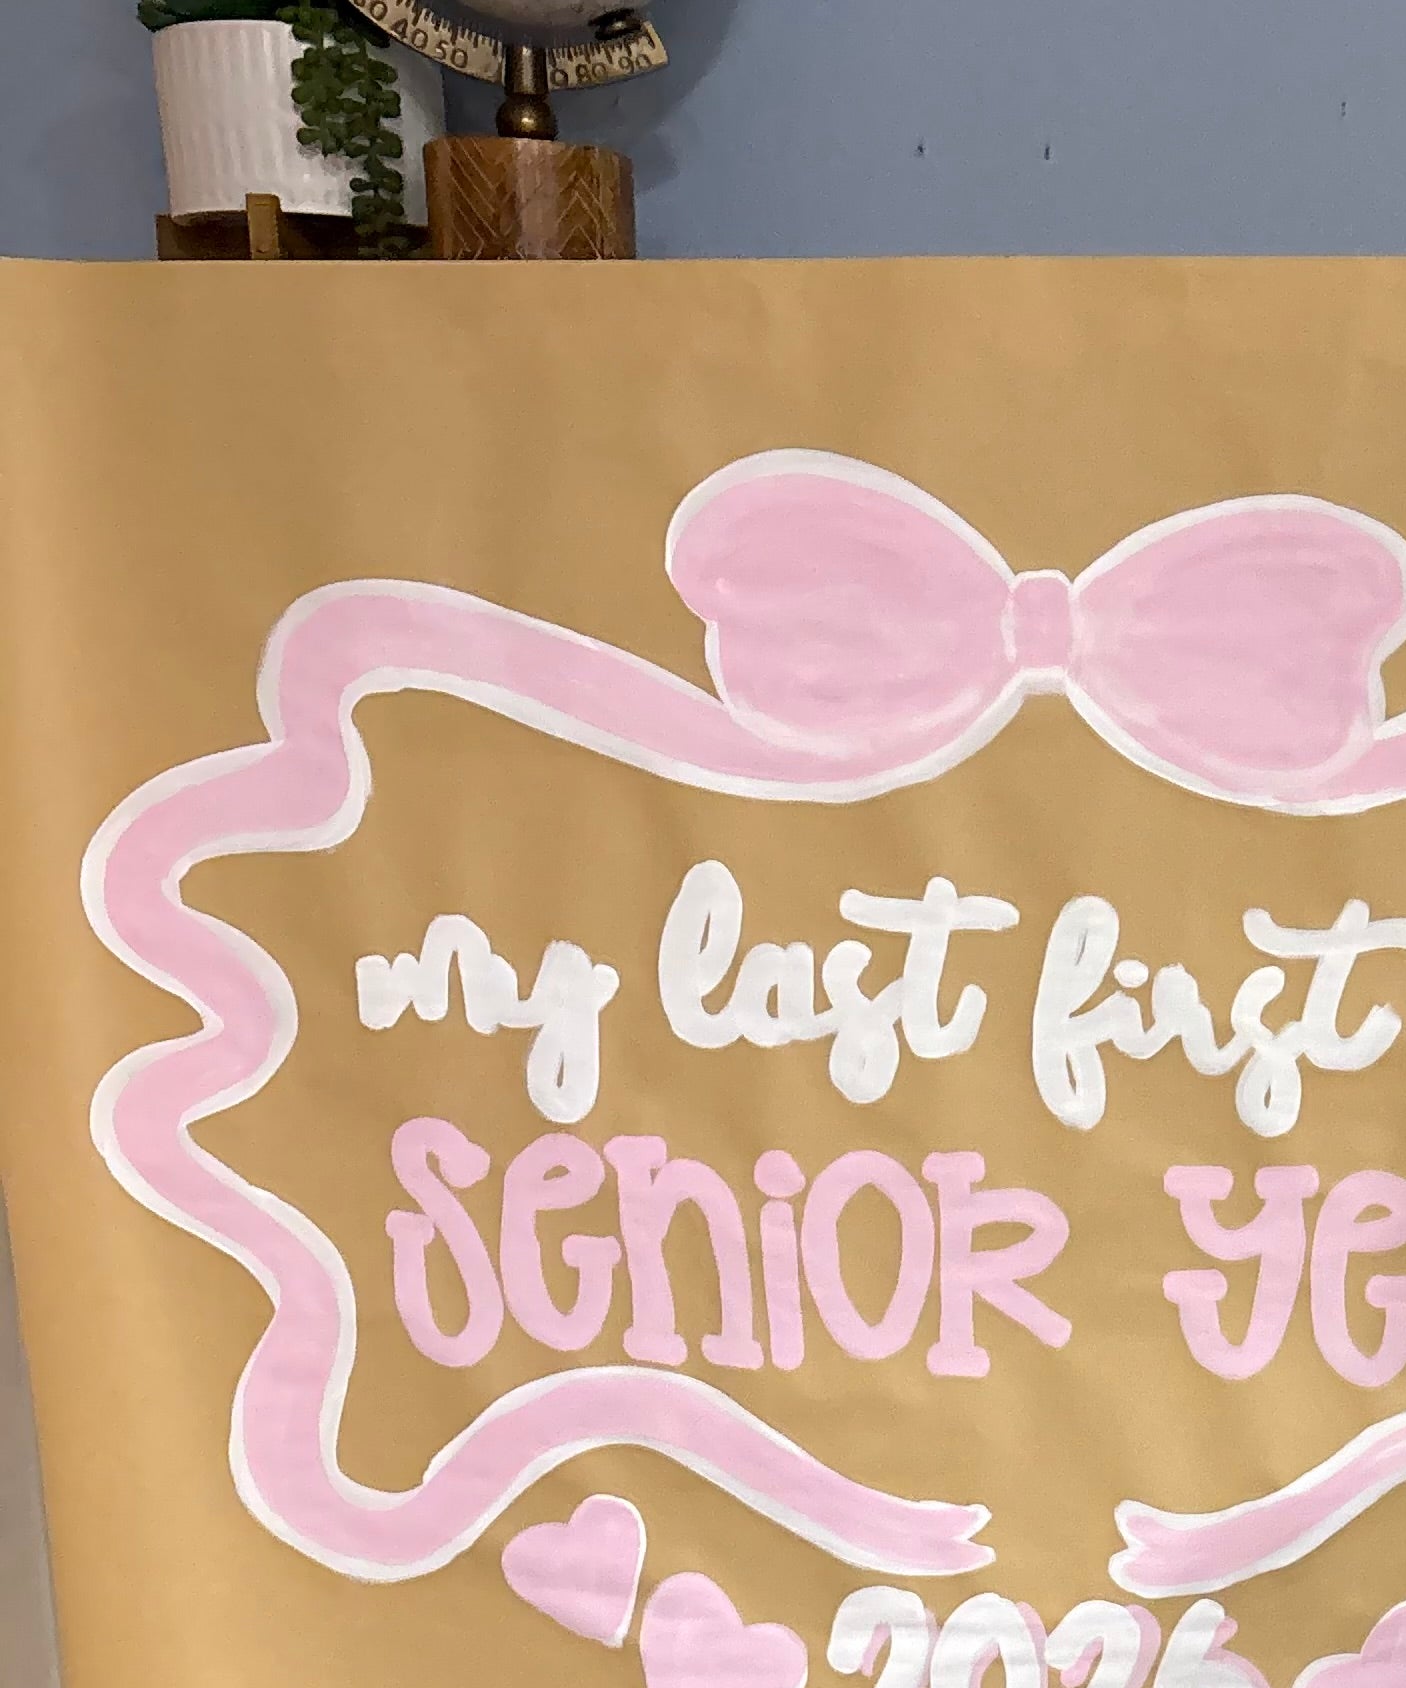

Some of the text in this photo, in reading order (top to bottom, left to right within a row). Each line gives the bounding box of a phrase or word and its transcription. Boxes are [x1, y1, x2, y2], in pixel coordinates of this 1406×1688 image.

[391, 18, 428, 50] 40
[617, 53, 653, 75] 90
[356, 914, 619, 1123] my
[658, 860, 1020, 1104] last
